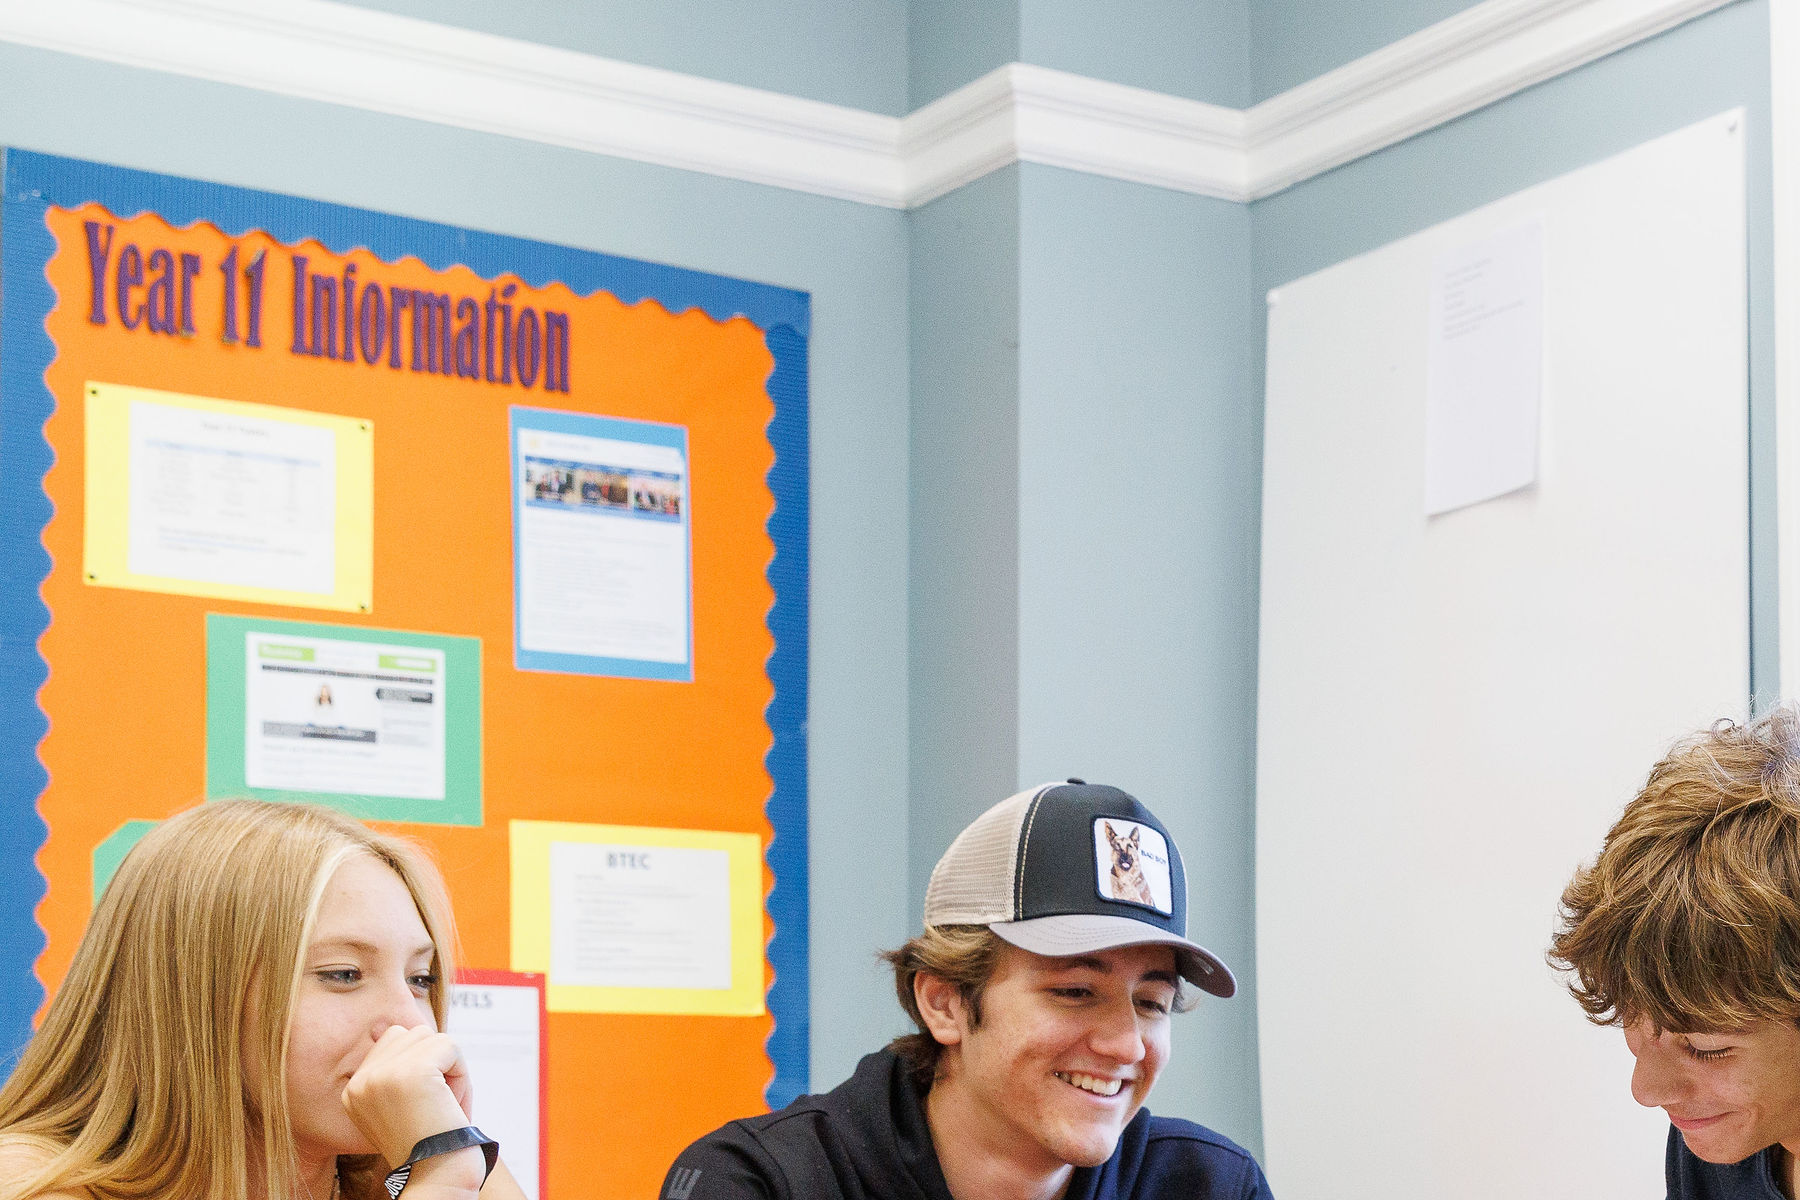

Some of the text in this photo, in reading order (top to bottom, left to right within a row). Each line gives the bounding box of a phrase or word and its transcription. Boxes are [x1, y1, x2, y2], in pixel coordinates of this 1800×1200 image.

[84, 221, 571, 393] Year 11 Information
[606, 853, 651, 870] BTEC
